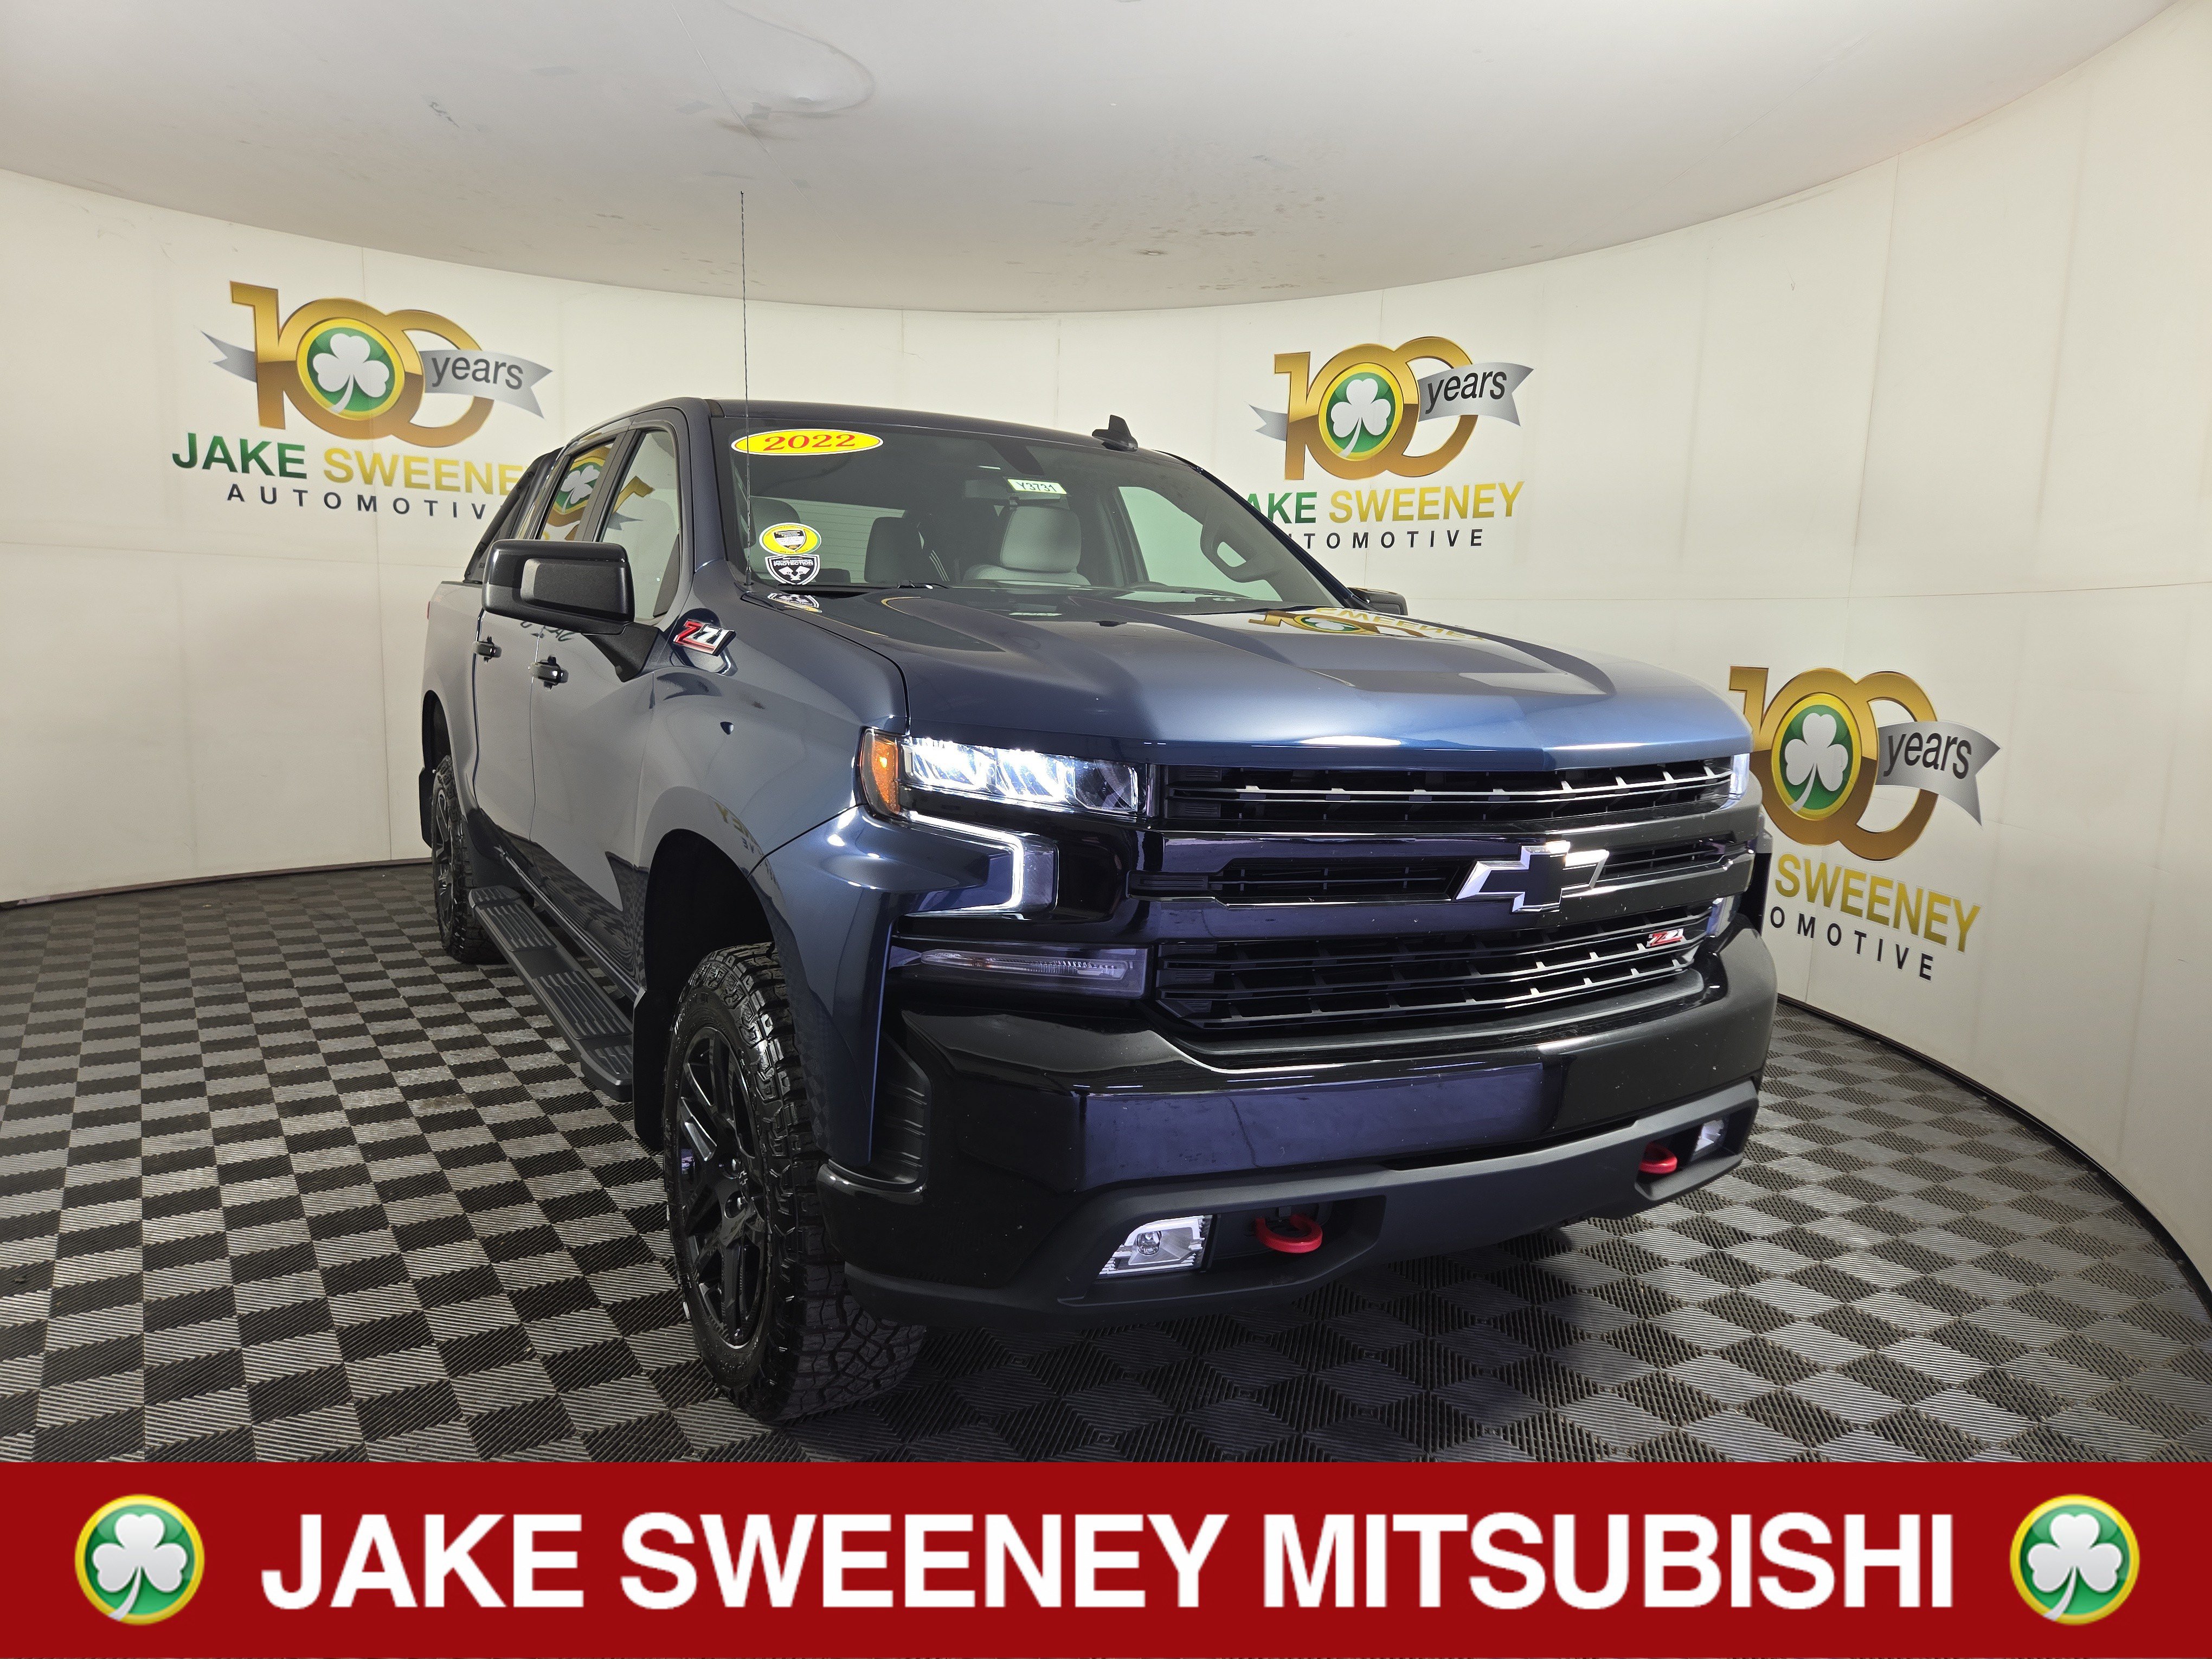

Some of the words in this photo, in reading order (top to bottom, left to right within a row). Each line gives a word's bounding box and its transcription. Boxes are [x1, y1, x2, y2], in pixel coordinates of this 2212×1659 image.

[229, 280, 494, 448] 100
[432, 355, 524, 390] years
[1274, 336, 1477, 481] 100
[1424, 370, 1507, 415] years
[172, 432, 308, 479] JAKE
[324, 448, 527, 496] SWEENE
[763, 434, 856, 451] 2022
[227, 483, 503, 520] AUTOMOTIV
[1015, 481, 1057, 492] Y3731
[1329, 481, 1525, 524] SWEENEY
[1288, 529, 1483, 550] TOMOTIVE
[673, 619, 736, 657] Z71
[1883, 731, 1972, 780] years
[1775, 853, 1982, 953] SWEENEY
[1770, 906, 1934, 981] OMOTIVE
